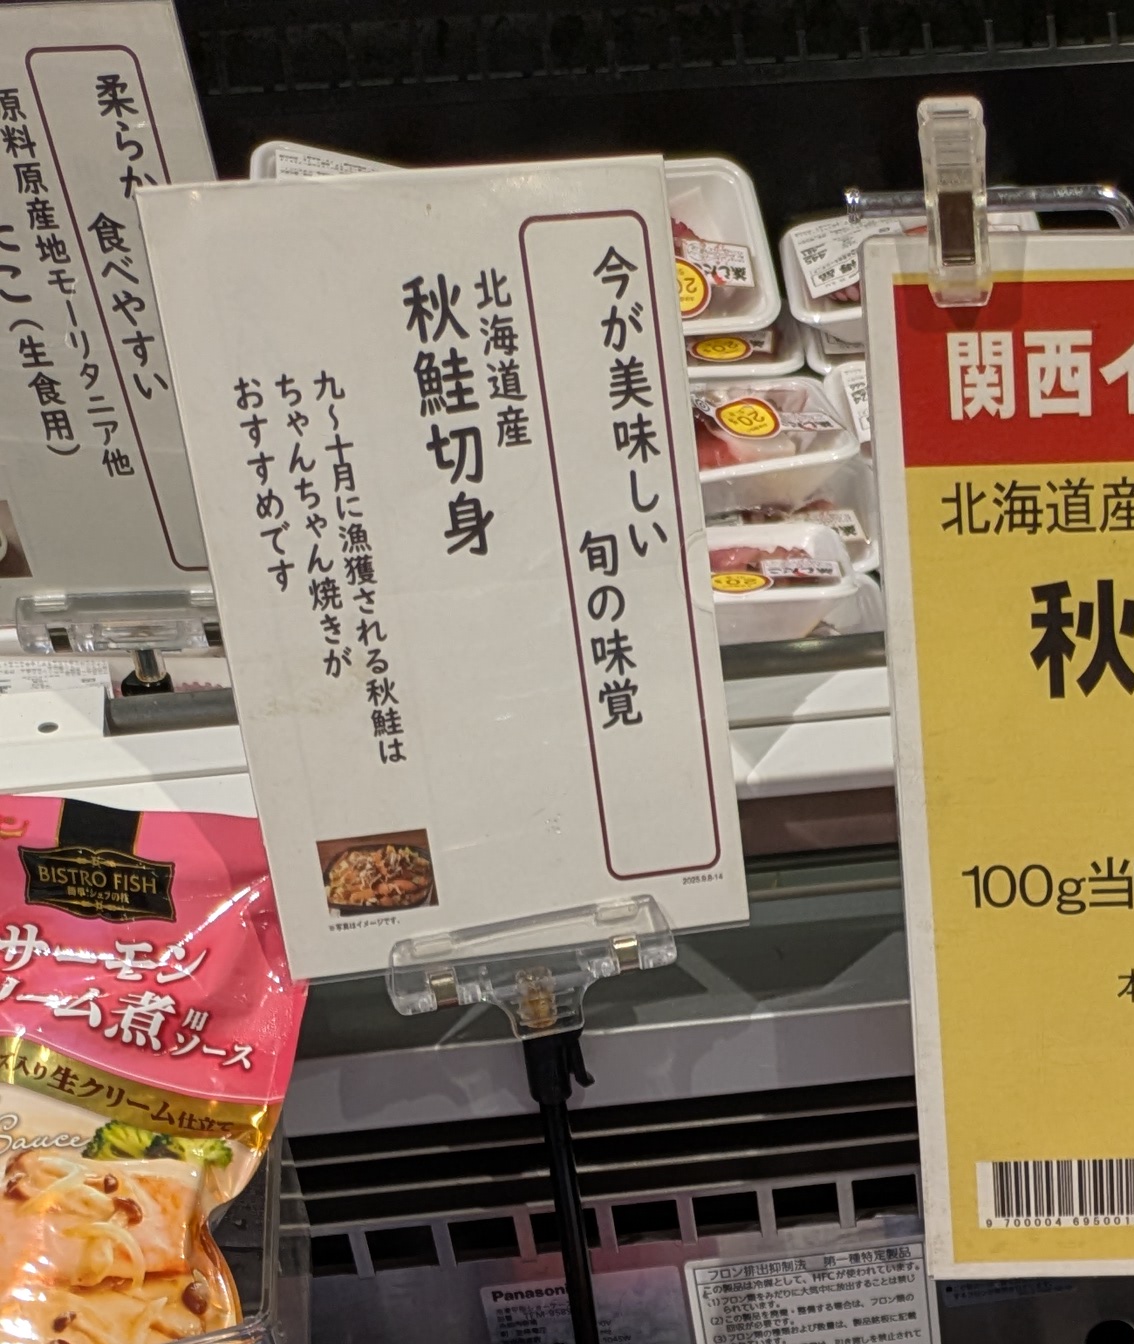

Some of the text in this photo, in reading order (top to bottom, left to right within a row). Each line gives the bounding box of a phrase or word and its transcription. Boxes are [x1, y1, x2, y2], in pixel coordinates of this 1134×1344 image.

[87, 212, 169, 400] 食べやすい
[474, 268, 533, 449] 北海道産
[232, 376, 295, 593] おすすめです
[401, 272, 495, 556] 秋鮭切身
[579, 245, 669, 729] 今が美味しい 旬の味覚
[275, 373, 353, 678] ちゃんちゃん焼きが
[0, 923, 208, 984] サーモン
[38, 866, 108, 889] BISTRO
[113, 873, 157, 895] FISH
[170, 1031, 254, 1071] ソース
